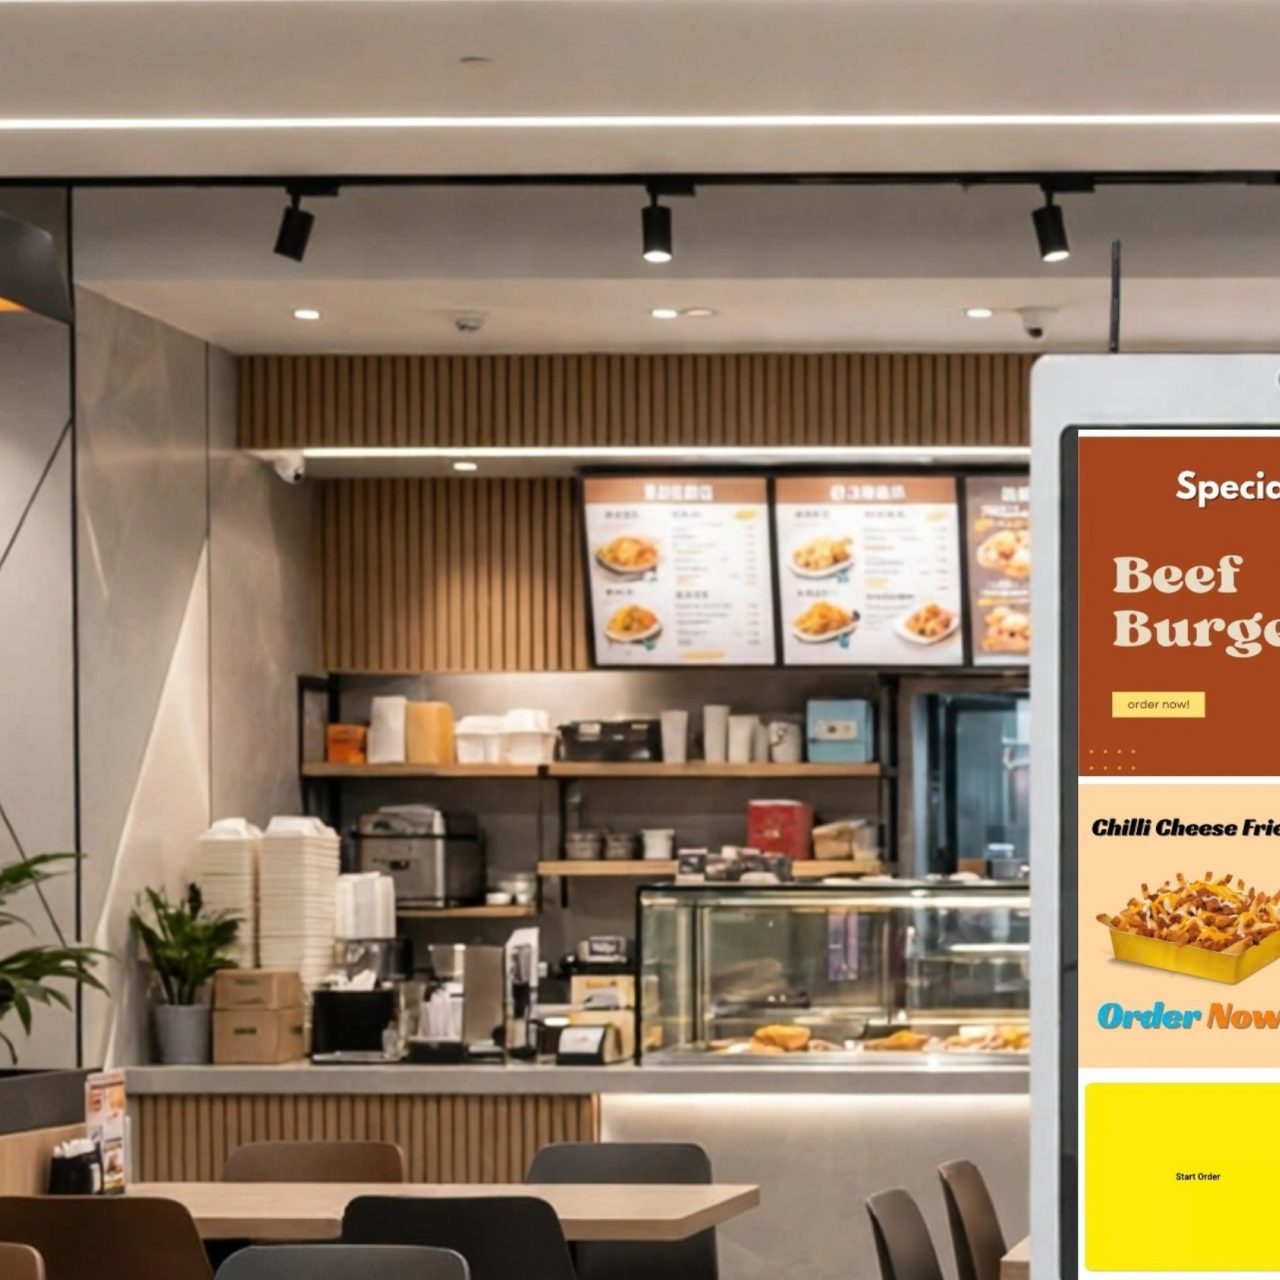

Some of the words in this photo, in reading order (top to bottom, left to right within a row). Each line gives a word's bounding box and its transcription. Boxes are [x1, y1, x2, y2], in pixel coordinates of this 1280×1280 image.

[1113, 554, 1244, 594] Beef
[1127, 698, 1159, 710] order
[1162, 698, 1190, 710] now!
[1091, 818, 1151, 837] Chilli
[1155, 818, 1238, 837] Cheese
[1097, 1001, 1201, 1030] Order
[1175, 1172, 1196, 1181] Start
[1198, 1172, 1221, 1181] Order
